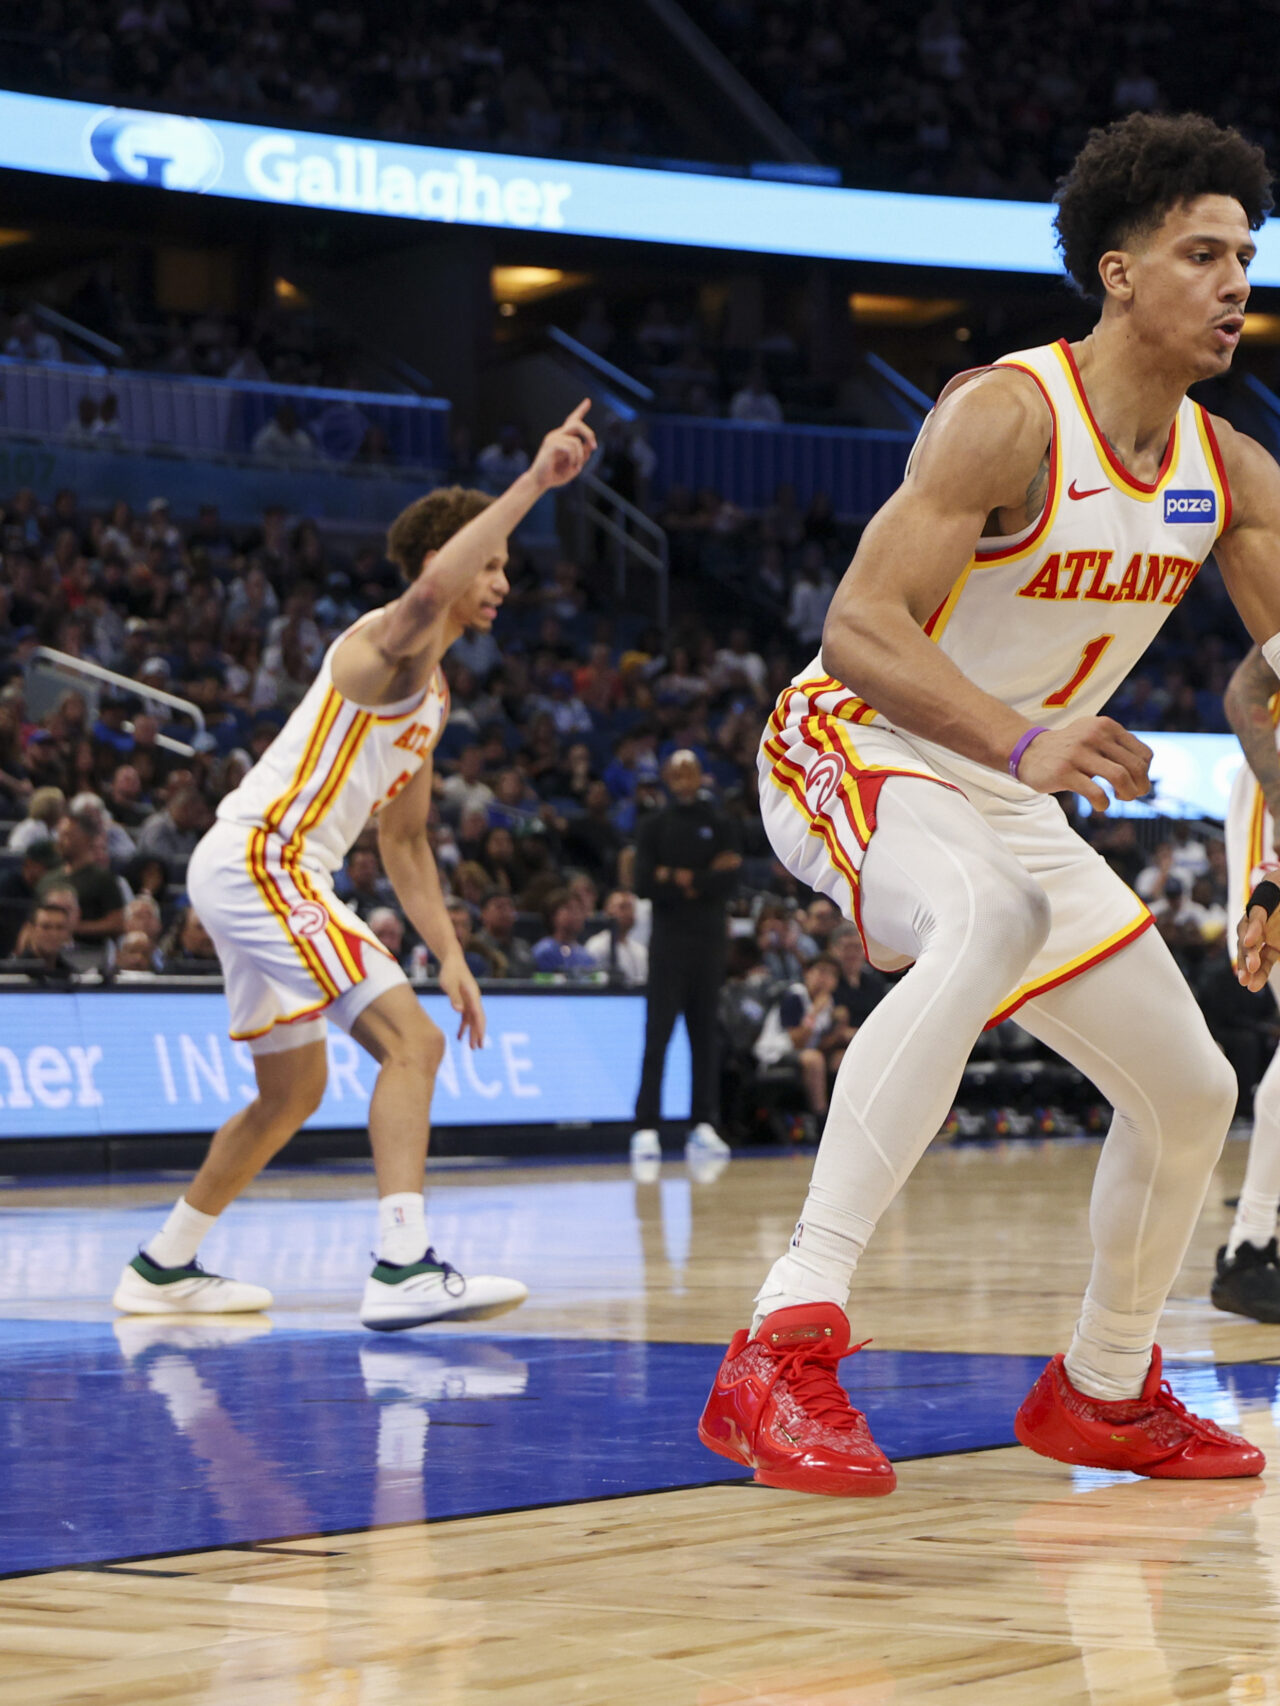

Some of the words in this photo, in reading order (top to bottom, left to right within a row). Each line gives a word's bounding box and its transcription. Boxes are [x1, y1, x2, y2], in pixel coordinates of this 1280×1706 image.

[244, 135, 572, 228] Gallagher
[1166, 496, 1213, 516] paze
[1042, 633, 1116, 709] 1
